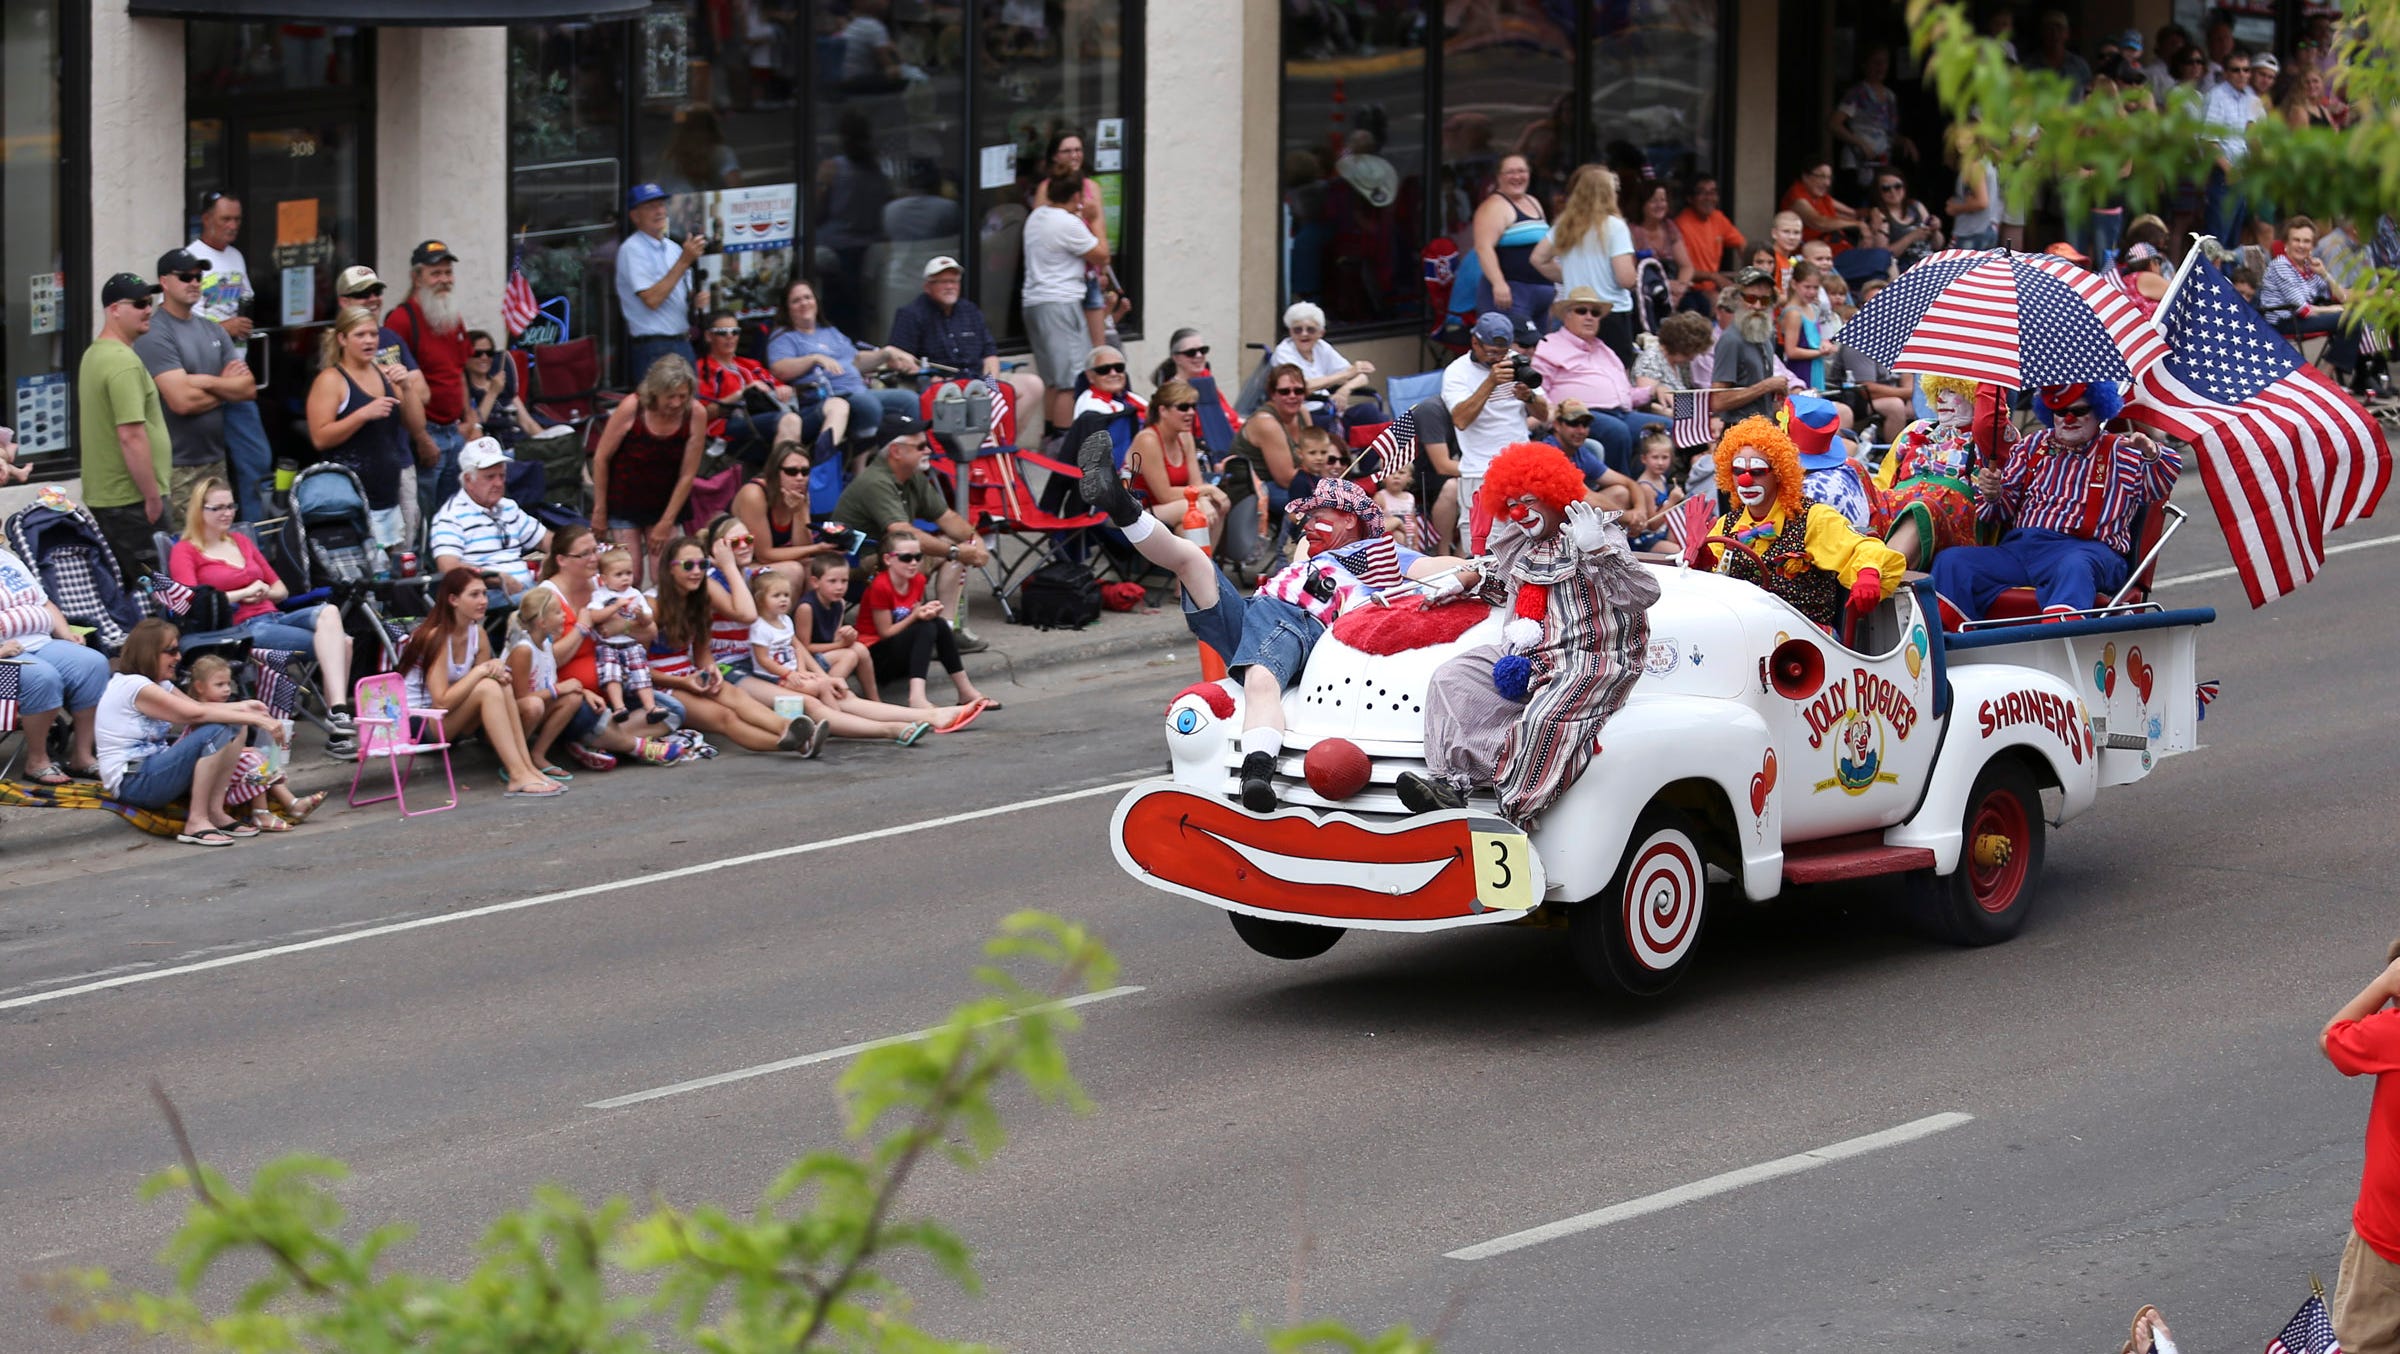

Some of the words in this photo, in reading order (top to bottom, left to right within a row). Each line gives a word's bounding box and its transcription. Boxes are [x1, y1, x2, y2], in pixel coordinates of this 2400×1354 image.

[290, 141, 316, 157] 308
[1803, 677, 1848, 750] JOLLY
[1853, 667, 1918, 741] ROGUES
[1978, 688, 2083, 766] SHRINERS
[1490, 840, 1512, 890] 3
